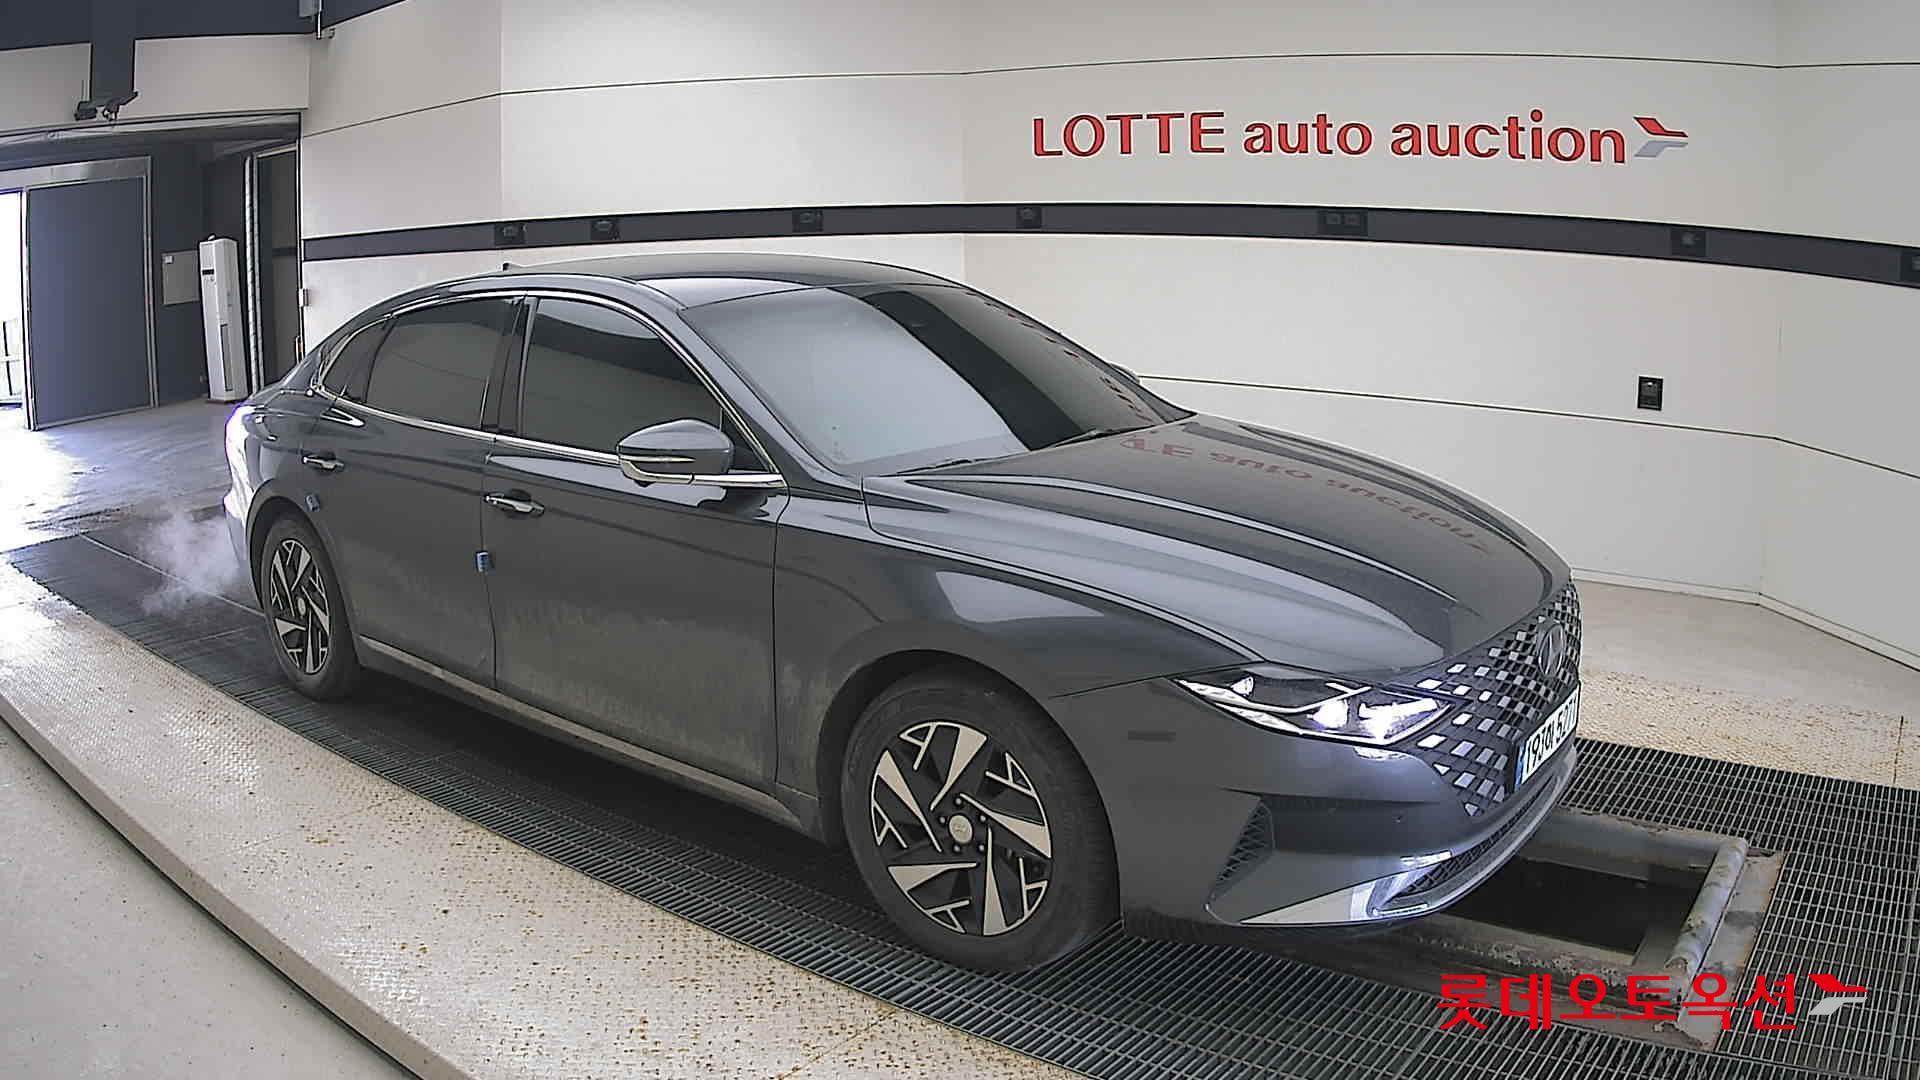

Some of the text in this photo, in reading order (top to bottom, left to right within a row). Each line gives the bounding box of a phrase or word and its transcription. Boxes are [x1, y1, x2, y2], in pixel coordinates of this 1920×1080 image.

[1032, 110, 1628, 163] LOTTE auto auction
